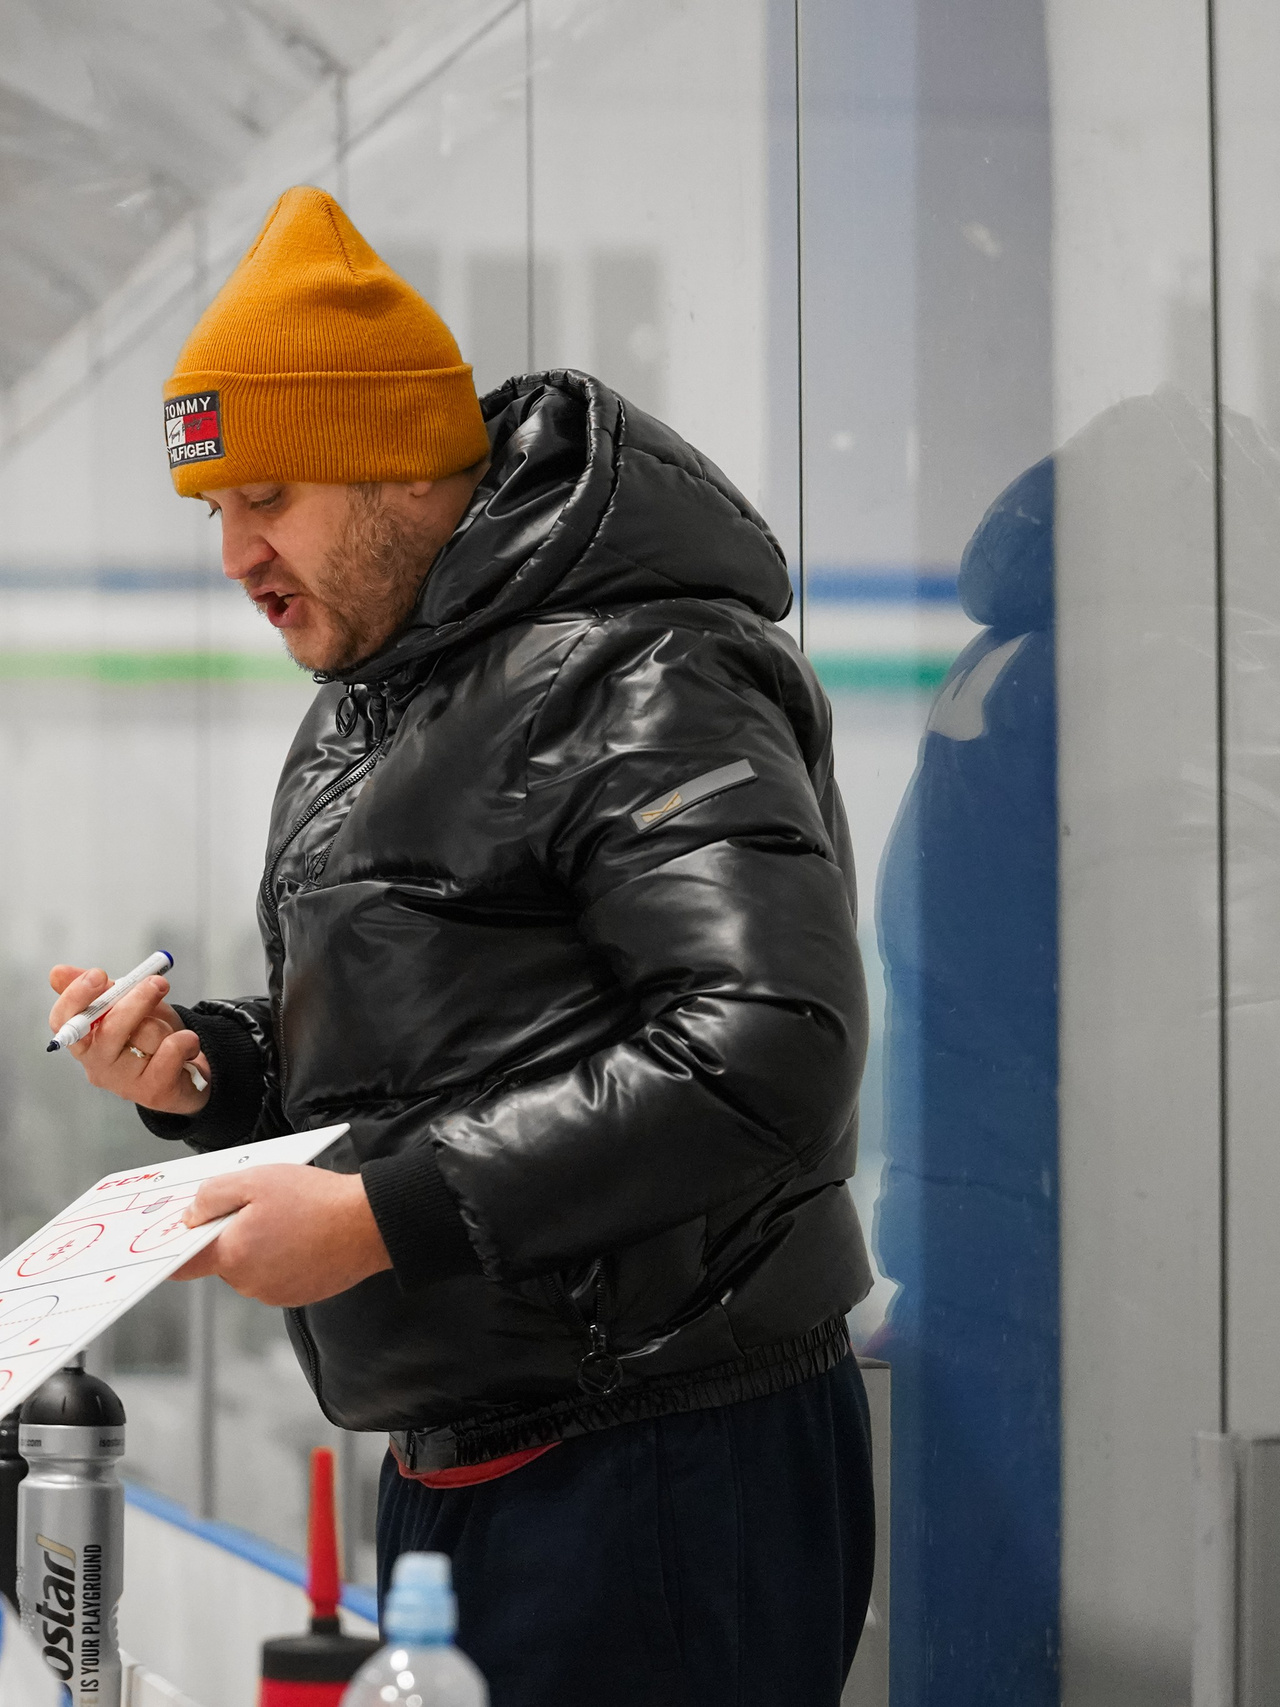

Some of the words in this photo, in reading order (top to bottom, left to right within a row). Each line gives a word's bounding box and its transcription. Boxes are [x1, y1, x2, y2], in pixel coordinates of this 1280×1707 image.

[165, 396, 211, 420] TOMMY
[166, 440, 217, 463] HILFIGER
[96, 1171, 162, 1191] CCM
[82, 1544, 102, 1635] PLAYGROUND
[35, 1550, 76, 1697] ostar
[80, 1639, 100, 1675] YOUR
[80, 1679, 99, 1693] IS
